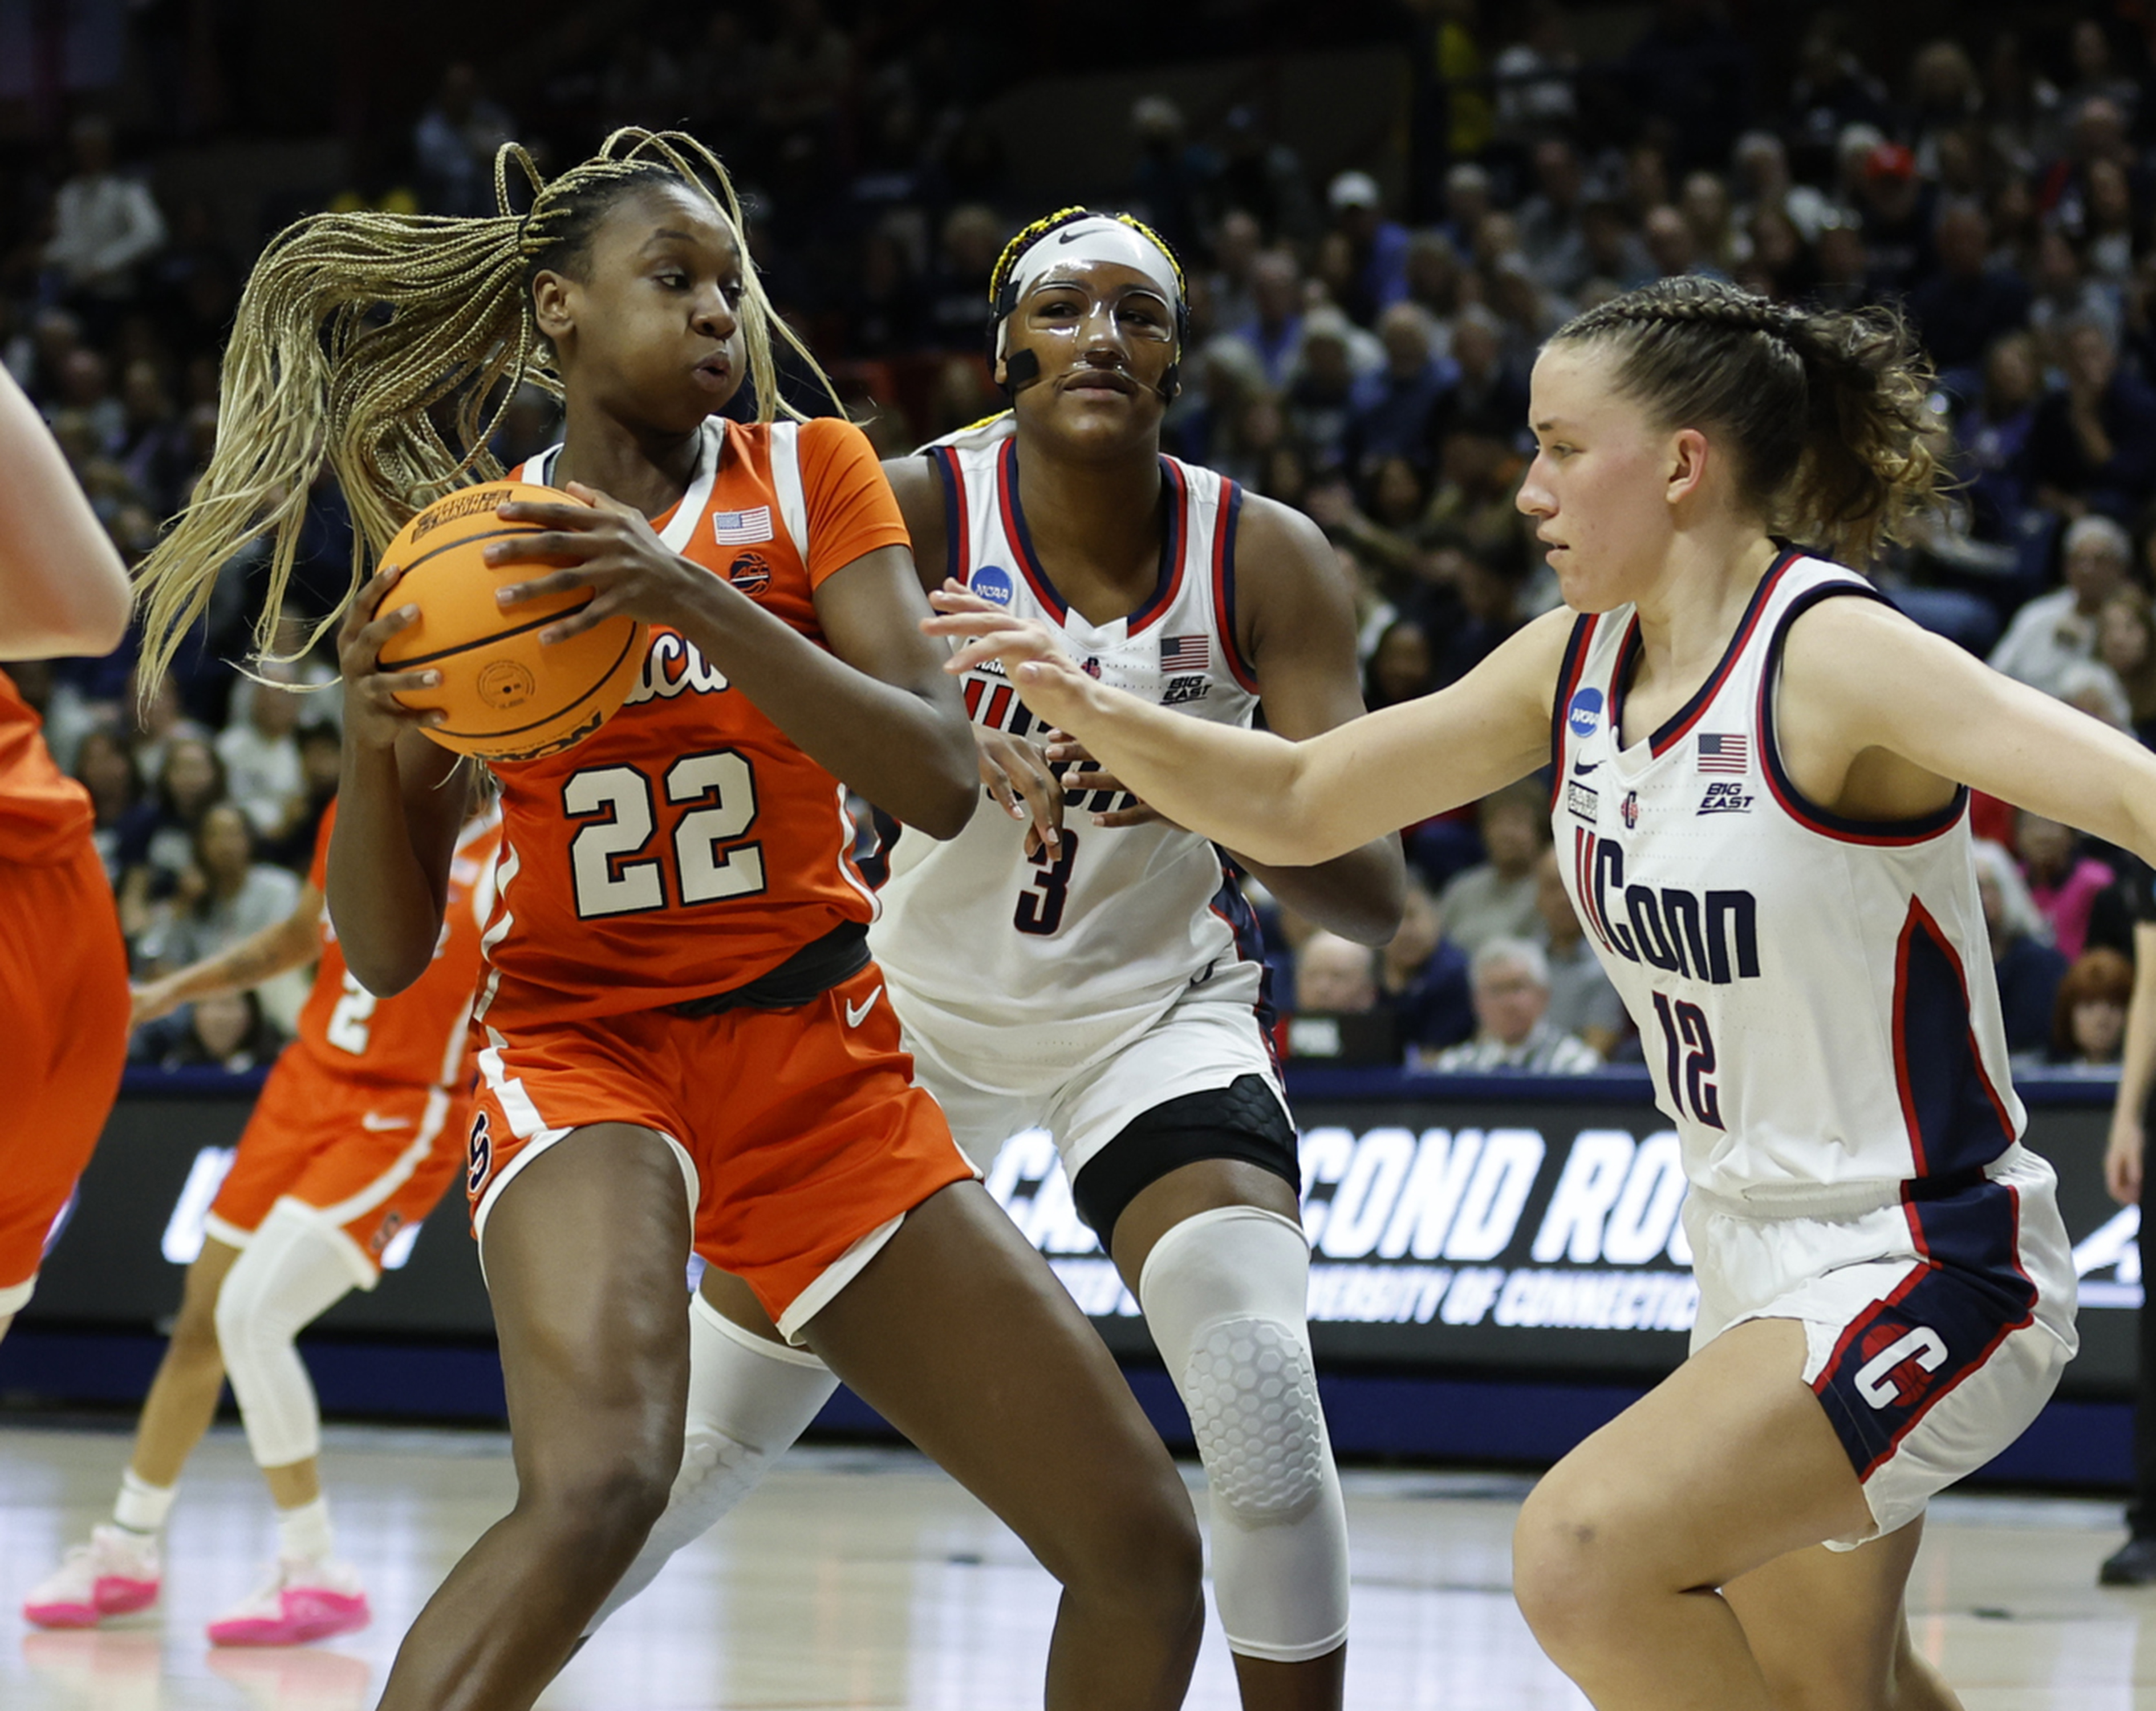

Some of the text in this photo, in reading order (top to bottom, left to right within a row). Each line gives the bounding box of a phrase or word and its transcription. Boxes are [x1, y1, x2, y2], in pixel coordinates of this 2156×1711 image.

[976, 583, 1009, 601] NCAA
[1163, 684, 1213, 701] EAST
[1169, 675, 1206, 689] BIG
[1700, 796, 1755, 808] EAST
[1706, 782, 1742, 796] BIG
[561, 747, 766, 922] 22
[1013, 828, 1078, 936] 3
[1576, 825, 1761, 984] UConn
[1652, 990, 1728, 1133] 12
[1297, 1127, 1546, 1260] COND
[1530, 1129, 1694, 1266] RO
[1440, 1266, 1507, 1326] OF
[1493, 1267, 1701, 1332] CONNECTIC
[1854, 1326, 1948, 1410] C
